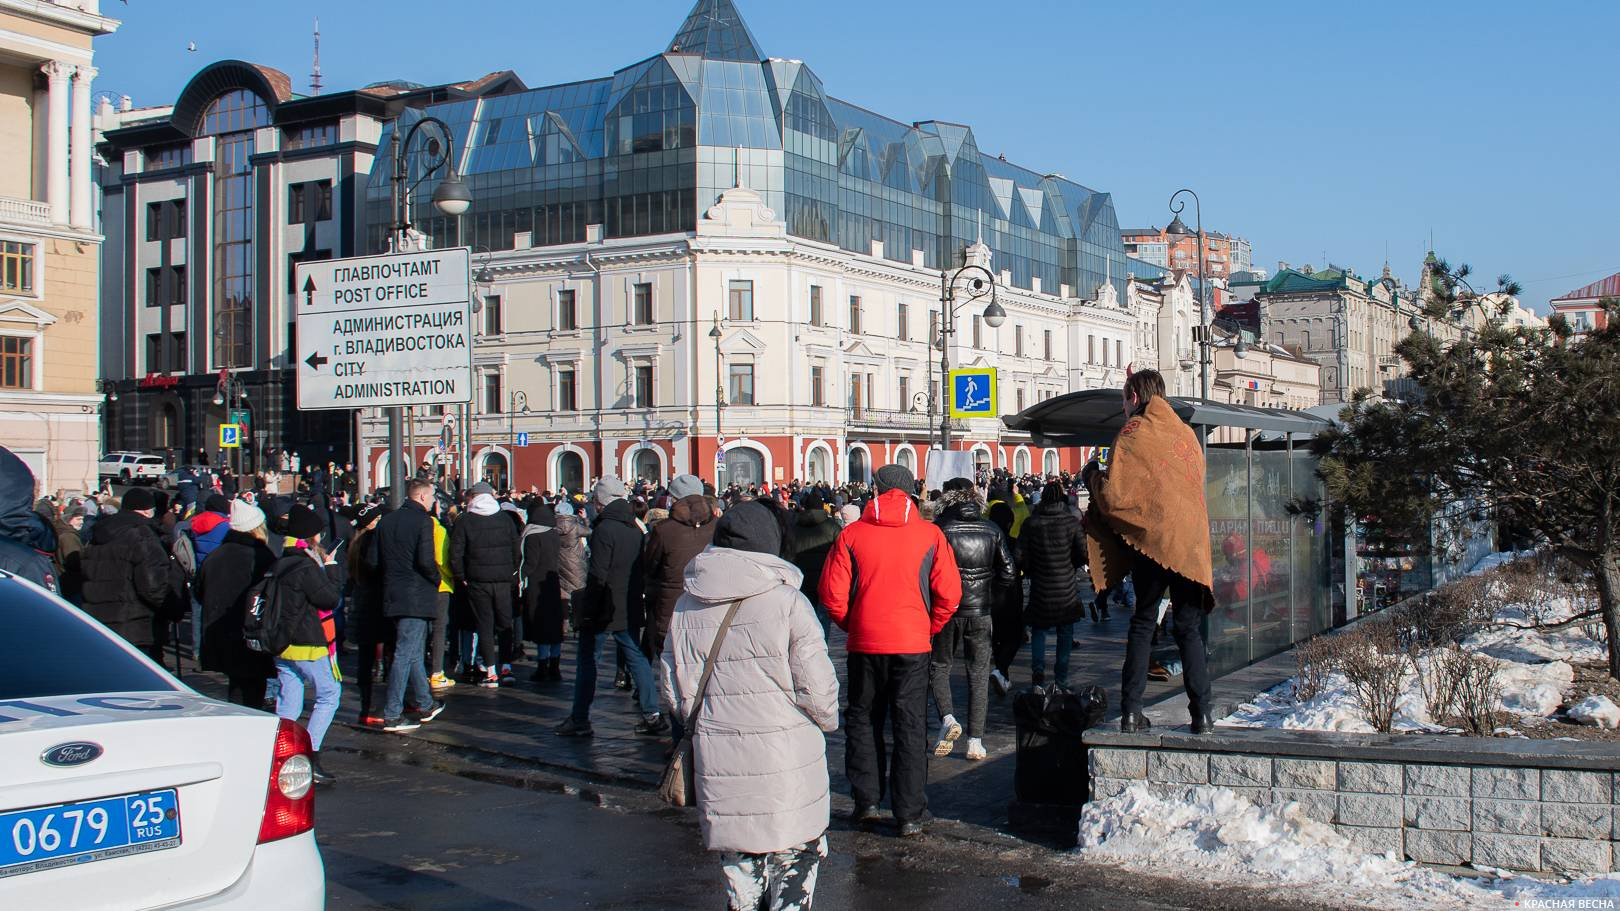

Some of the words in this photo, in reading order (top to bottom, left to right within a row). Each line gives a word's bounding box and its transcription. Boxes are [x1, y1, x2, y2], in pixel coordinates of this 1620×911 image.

[334, 260, 441, 283] ГЛАВПОЧТАМТ
[335, 288, 371, 304] POST
[375, 283, 428, 301] OFFICE
[333, 311, 463, 336] АДМИНИСТРАЦИЯ
[334, 344, 342, 356] г.
[346, 333, 465, 356] ВЛАДИВОСТОКА
[334, 361, 365, 377] CITY
[334, 379, 455, 399] ADMINISTRATION
[58, 746, 92, 763] Ford
[131, 797, 165, 828] 25
[12, 807, 109, 856] 0679
[137, 827, 162, 838] RUS
